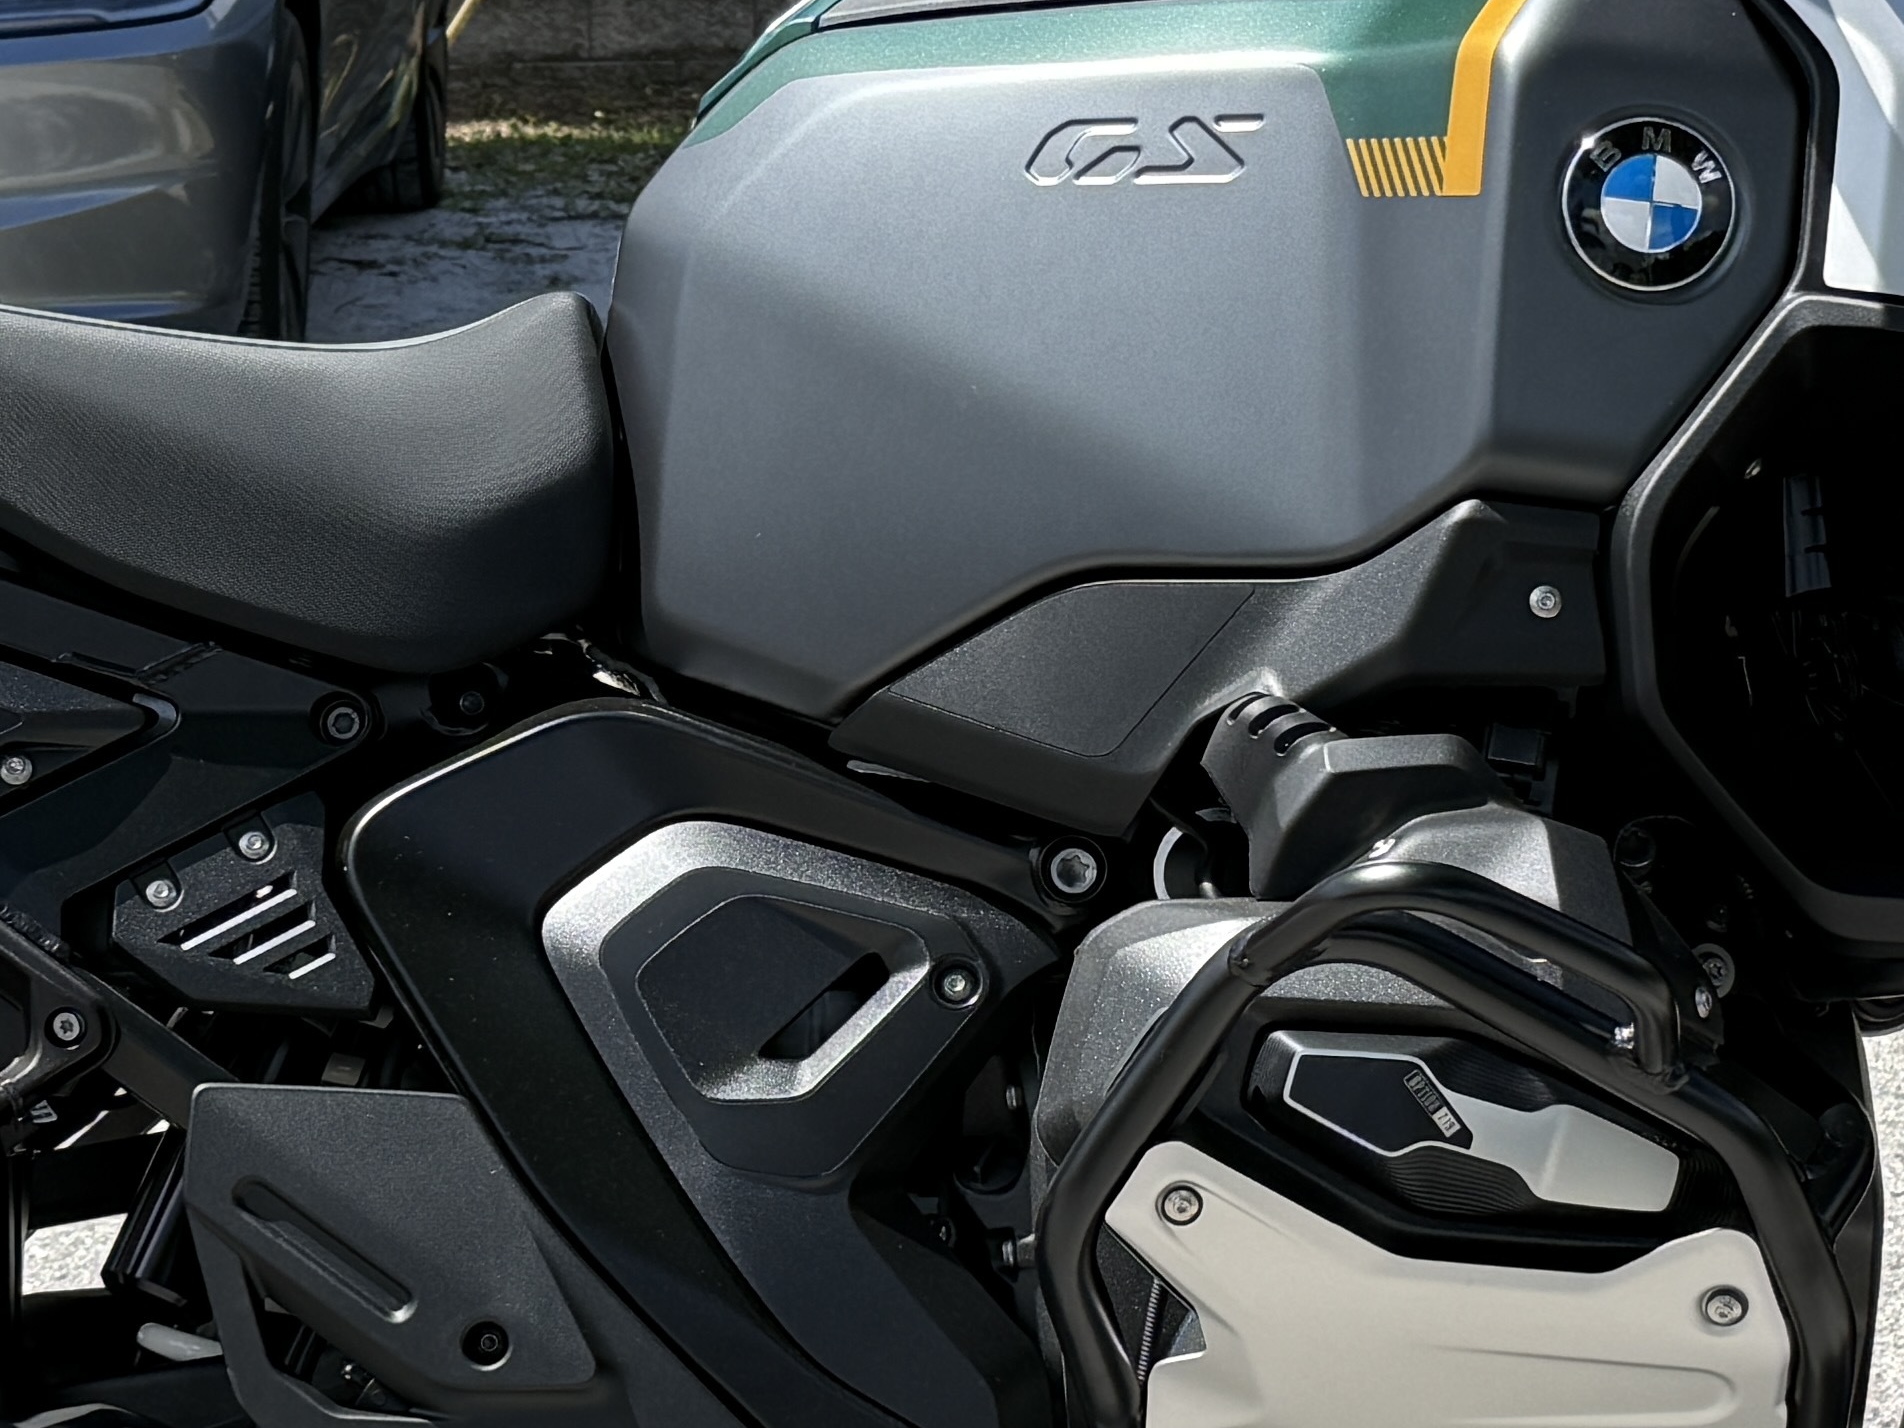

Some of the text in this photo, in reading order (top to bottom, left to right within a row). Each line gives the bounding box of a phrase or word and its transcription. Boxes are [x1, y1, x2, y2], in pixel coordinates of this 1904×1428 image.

[1022, 112, 1267, 188] GS
[1590, 126, 1723, 187] BMW
[1407, 1074, 1441, 1113] OPTION
